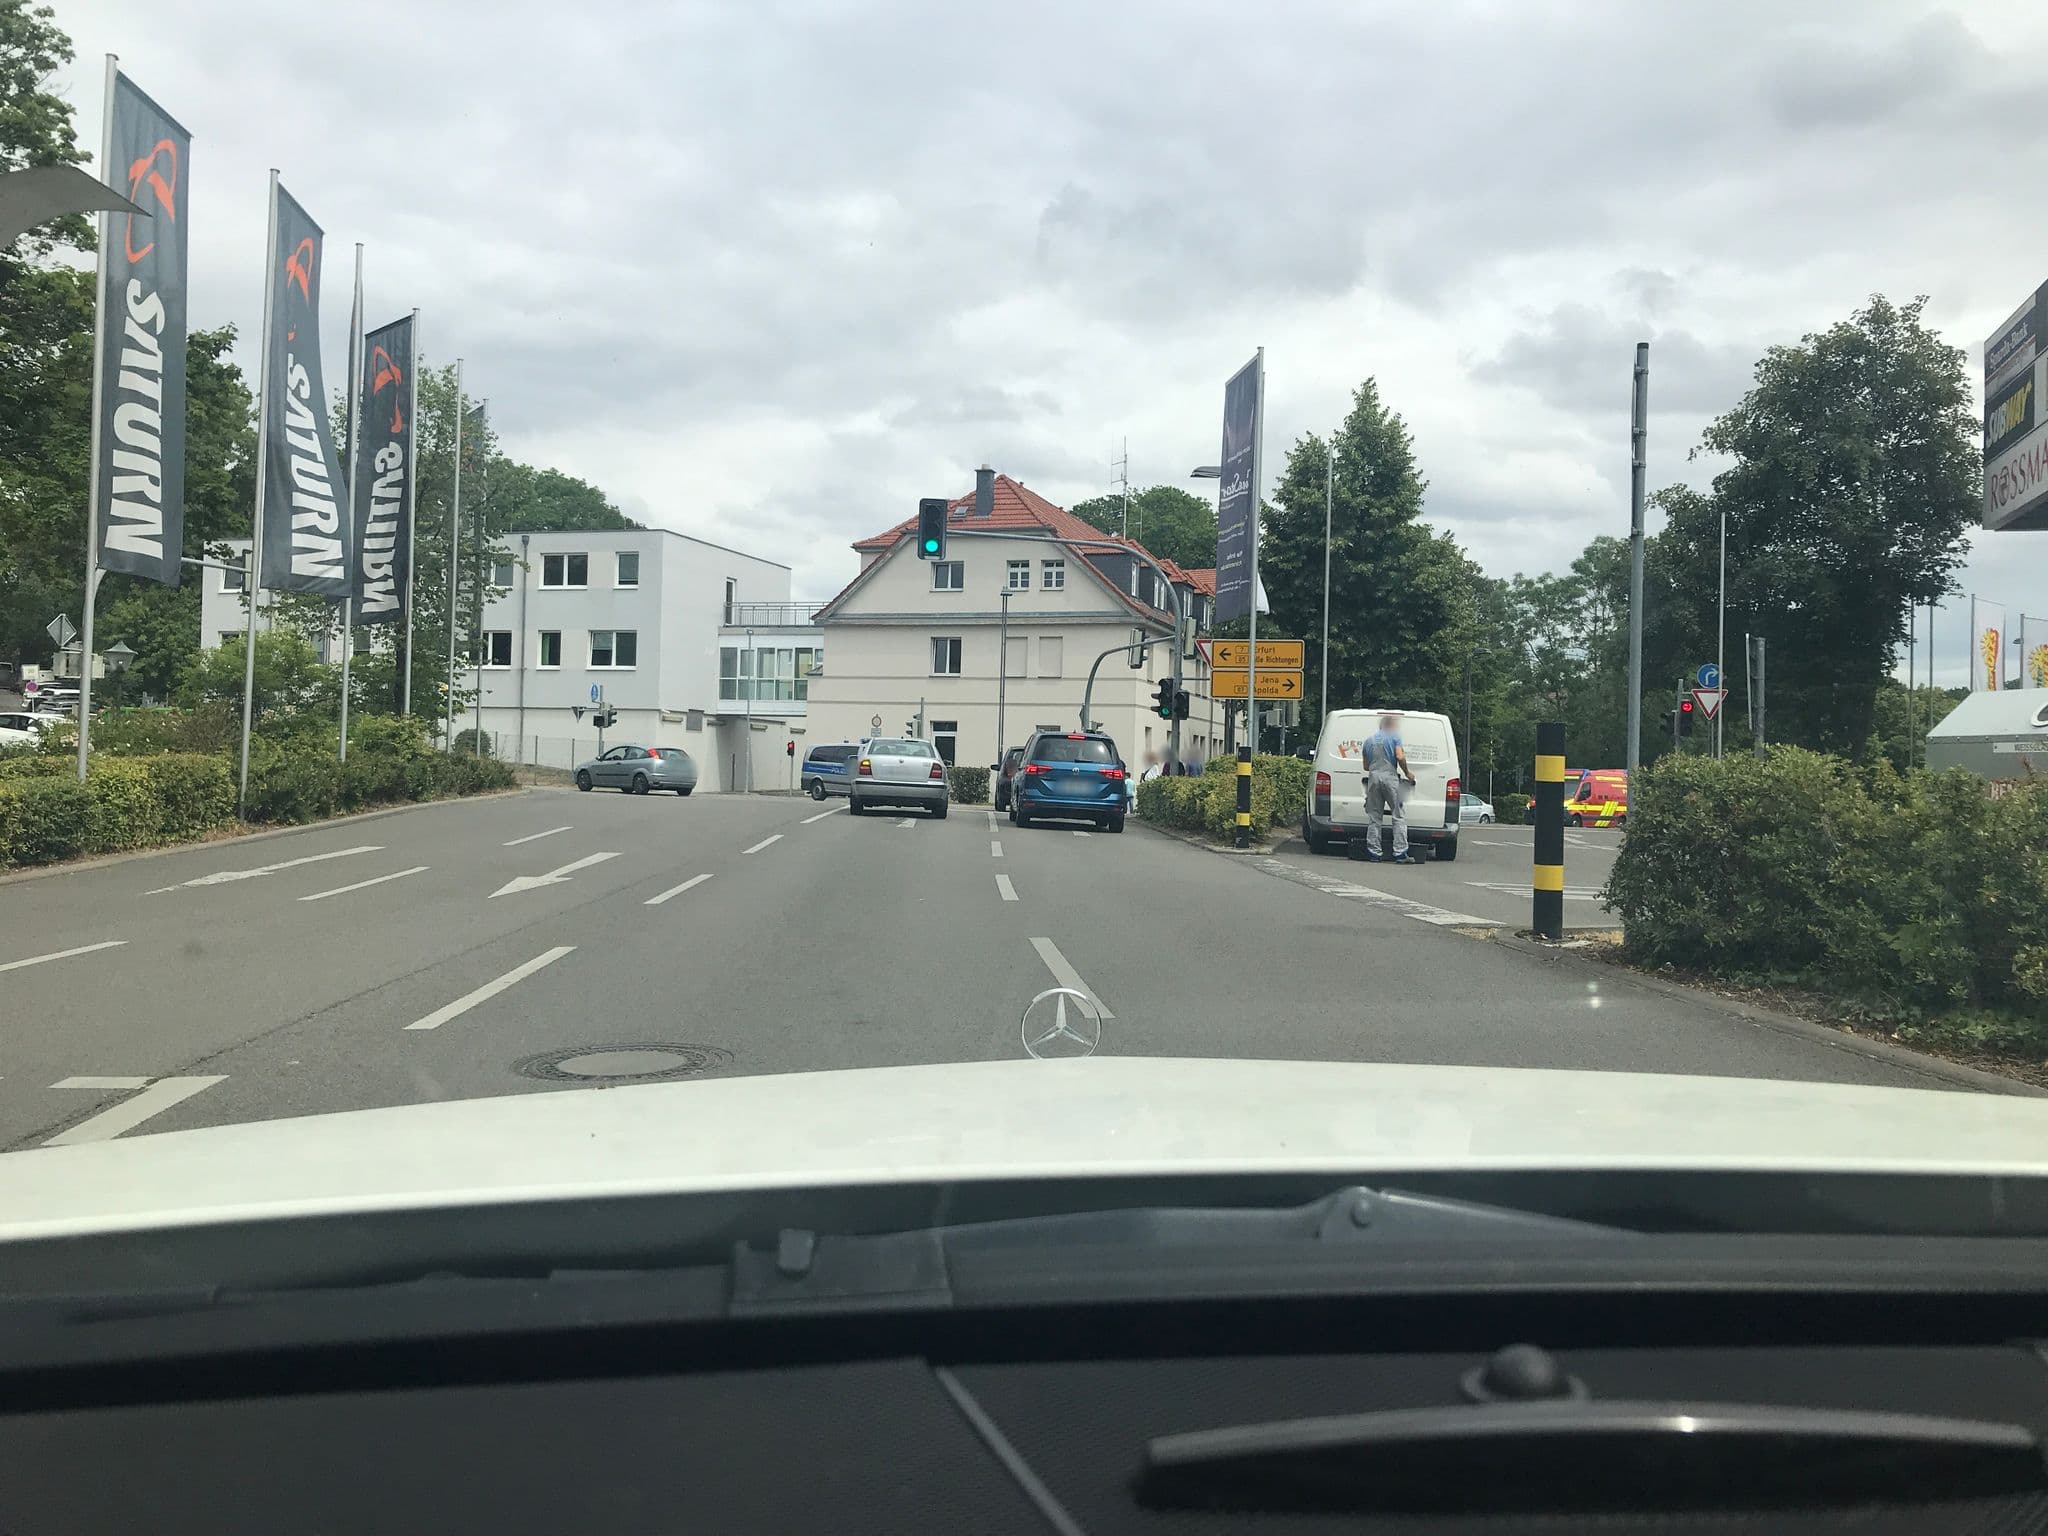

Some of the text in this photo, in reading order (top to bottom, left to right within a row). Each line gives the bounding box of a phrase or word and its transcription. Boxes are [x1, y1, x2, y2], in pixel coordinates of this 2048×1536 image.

[104, 278, 165, 560] SATURN
[285, 352, 345, 580] SATURN
[1985, 380, 2032, 449] SUBWAY
[1260, 676, 1280, 684] Jena
